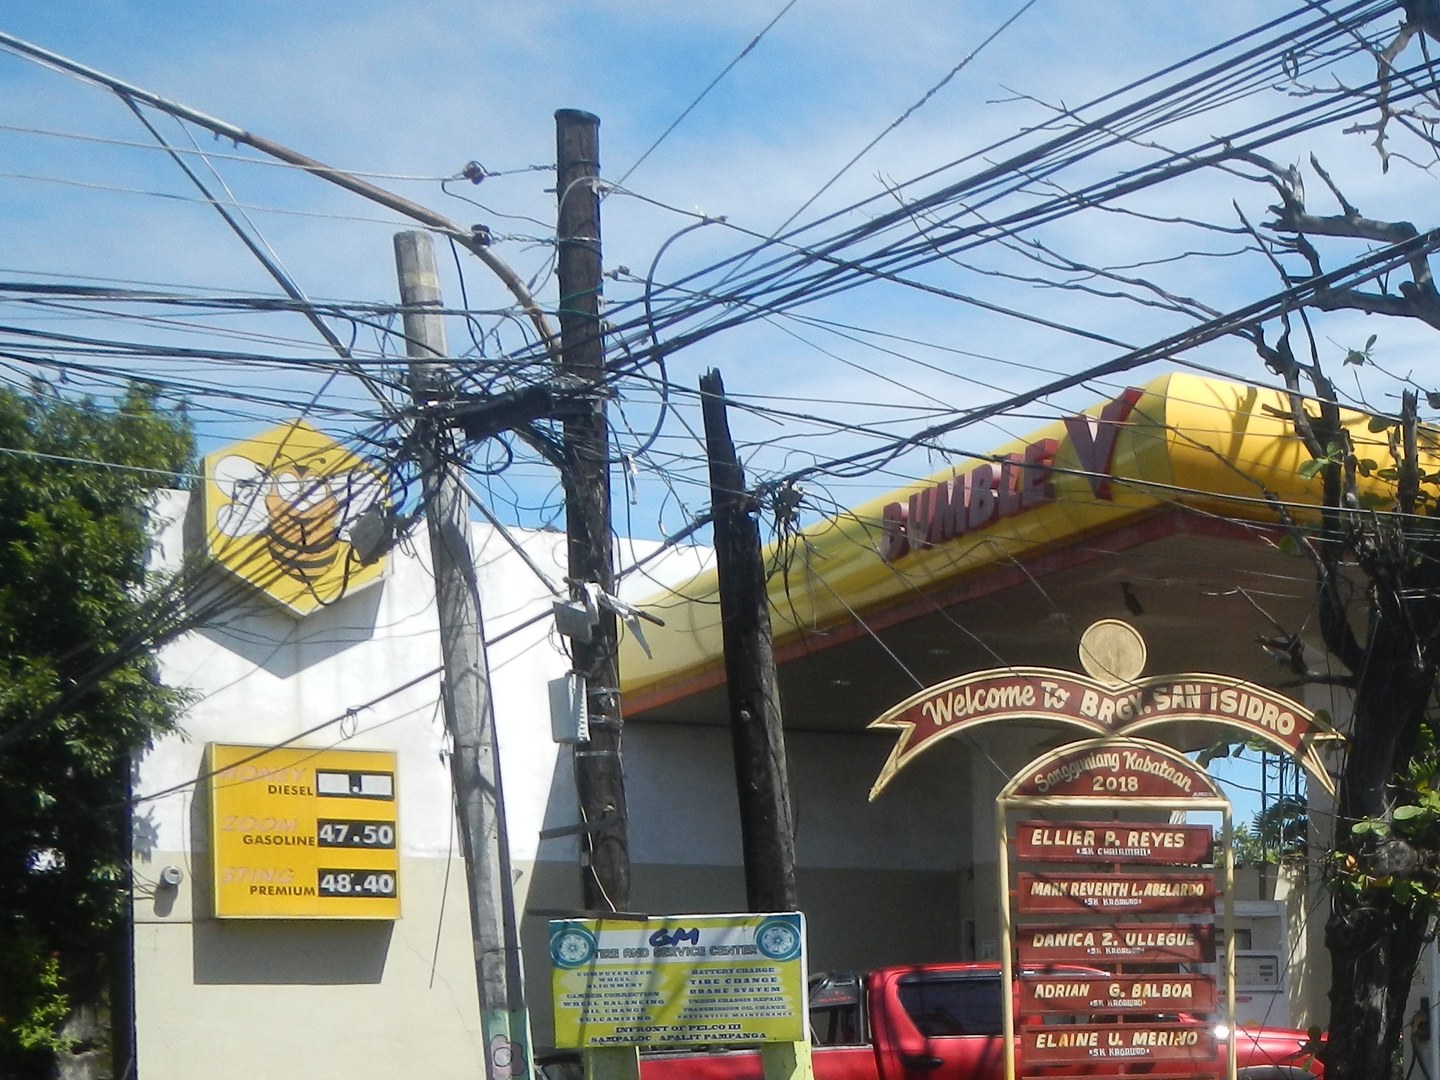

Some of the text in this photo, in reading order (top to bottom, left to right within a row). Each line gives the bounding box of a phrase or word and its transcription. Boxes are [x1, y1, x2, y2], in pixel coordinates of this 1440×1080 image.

[881, 386, 1146, 562] BUMBLE Y
[922, 681, 1296, 736] Welcome To BRGY. SAN ISIDRO
[1034, 751, 1194, 792] Sangguniang Kabataan
[267, 784, 314, 796] DIESEL
[1092, 776, 1139, 792] 2018
[221, 815, 298, 833] ZOOM
[242, 824, 394, 846] GASOLINE 47.50
[1031, 829, 1186, 848] ELLIER P. REYES
[221, 866, 295, 884] STING
[249, 873, 395, 897] PREMIUM 48.40
[1031, 881, 1206, 898] MARK REVENTH L. ABELARDO
[649, 927, 700, 947] GM
[1032, 932, 1095, 948] DANICA
[1125, 932, 1196, 947] ULLEGUE
[622, 948, 650, 959] AND
[653, 945, 706, 959] SERVICE
[709, 944, 758, 956] CENTER
[691, 967, 776, 976] BATTERY CHARGE
[725, 977, 778, 985] CHANGE
[1033, 982, 1193, 999] ADRIAN G. BALBOA
[615, 1025, 669, 1034] INFRONT
[688, 1023, 726, 1032] PELCO
[591, 1031, 768, 1044] SAMPALOC APALIT PAMPANGA
[1035, 1031, 1199, 1049] ELAINE U. MERINO
